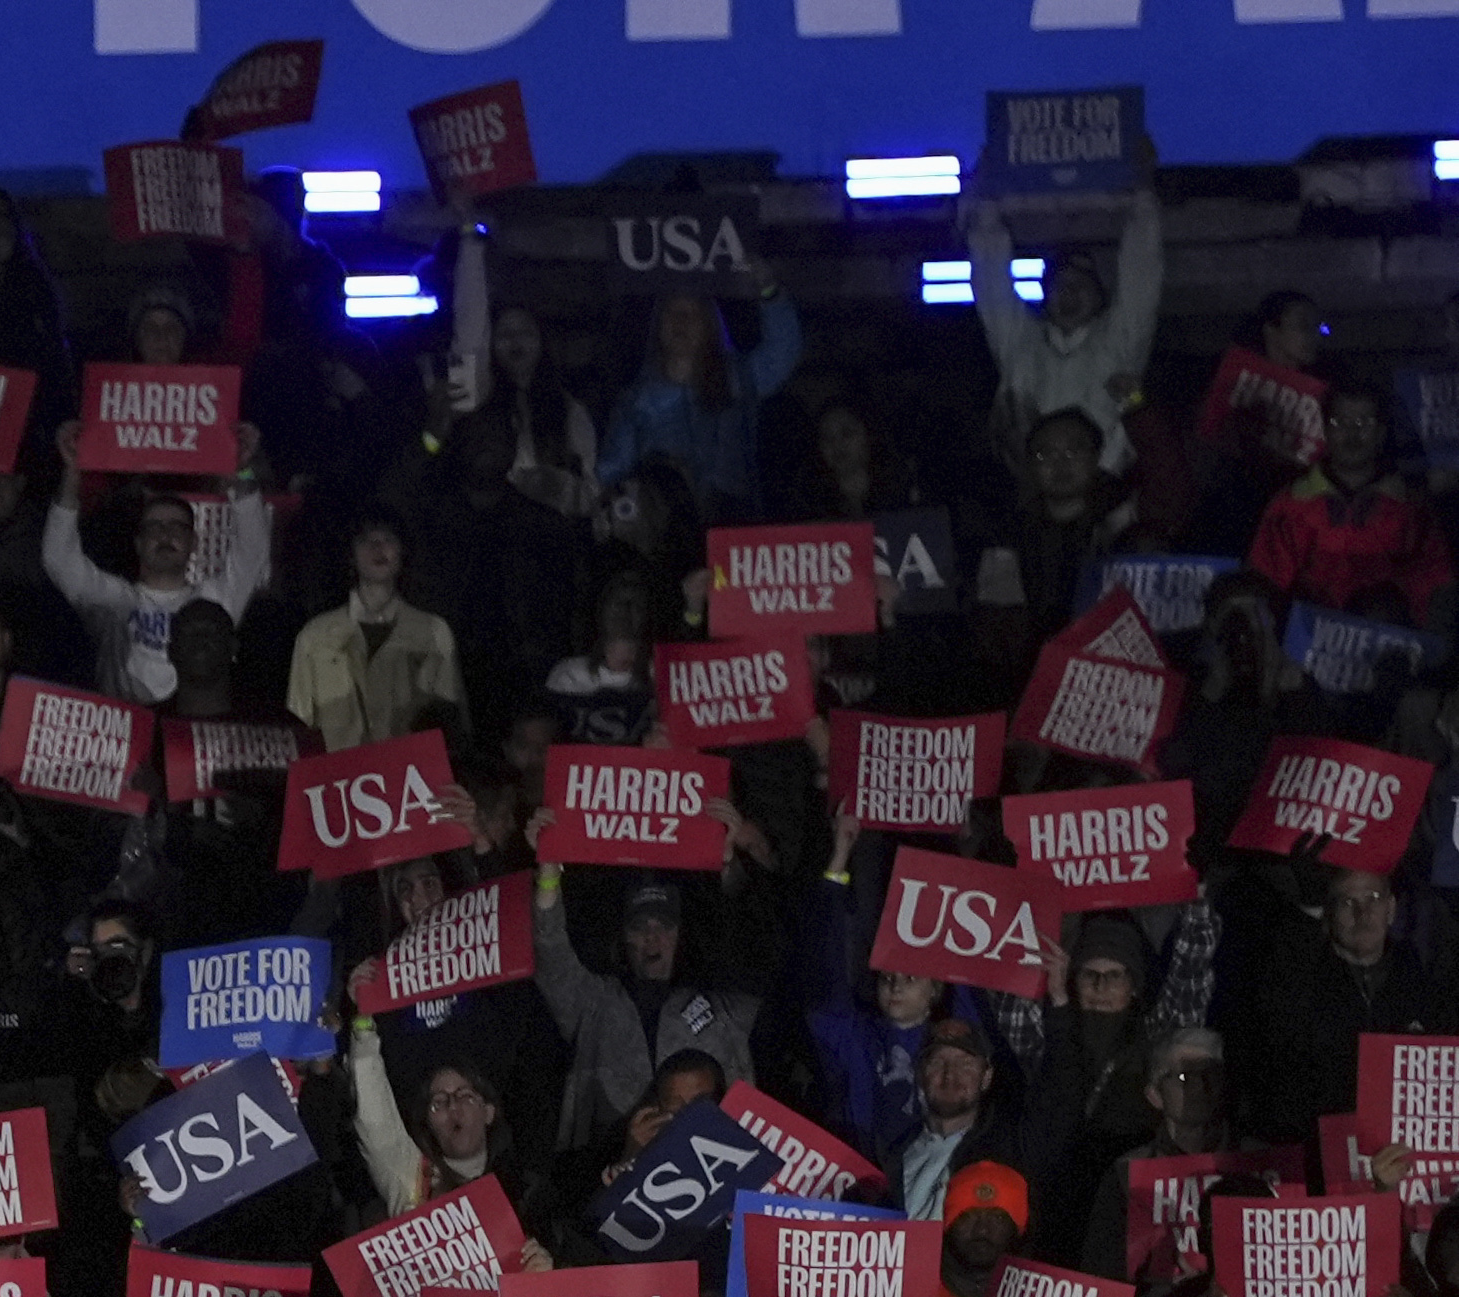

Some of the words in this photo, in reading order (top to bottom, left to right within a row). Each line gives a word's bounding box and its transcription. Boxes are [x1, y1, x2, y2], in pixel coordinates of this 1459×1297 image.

[101, 383, 217, 424] HARRIS
[117, 426, 197, 450] WALZ
[305, 765, 448, 847] USA
[1030, 804, 1168, 860] HARRIS
[1053, 855, 1149, 885] WALZ
[897, 879, 1042, 964] USA
[189, 951, 250, 993] VOTE
[259, 948, 310, 984] FOR
[188, 985, 310, 1029] FREEDOM
[1243, 1206, 1365, 1243] FREEDOM
[1244, 1243, 1365, 1279] FREEDOM
